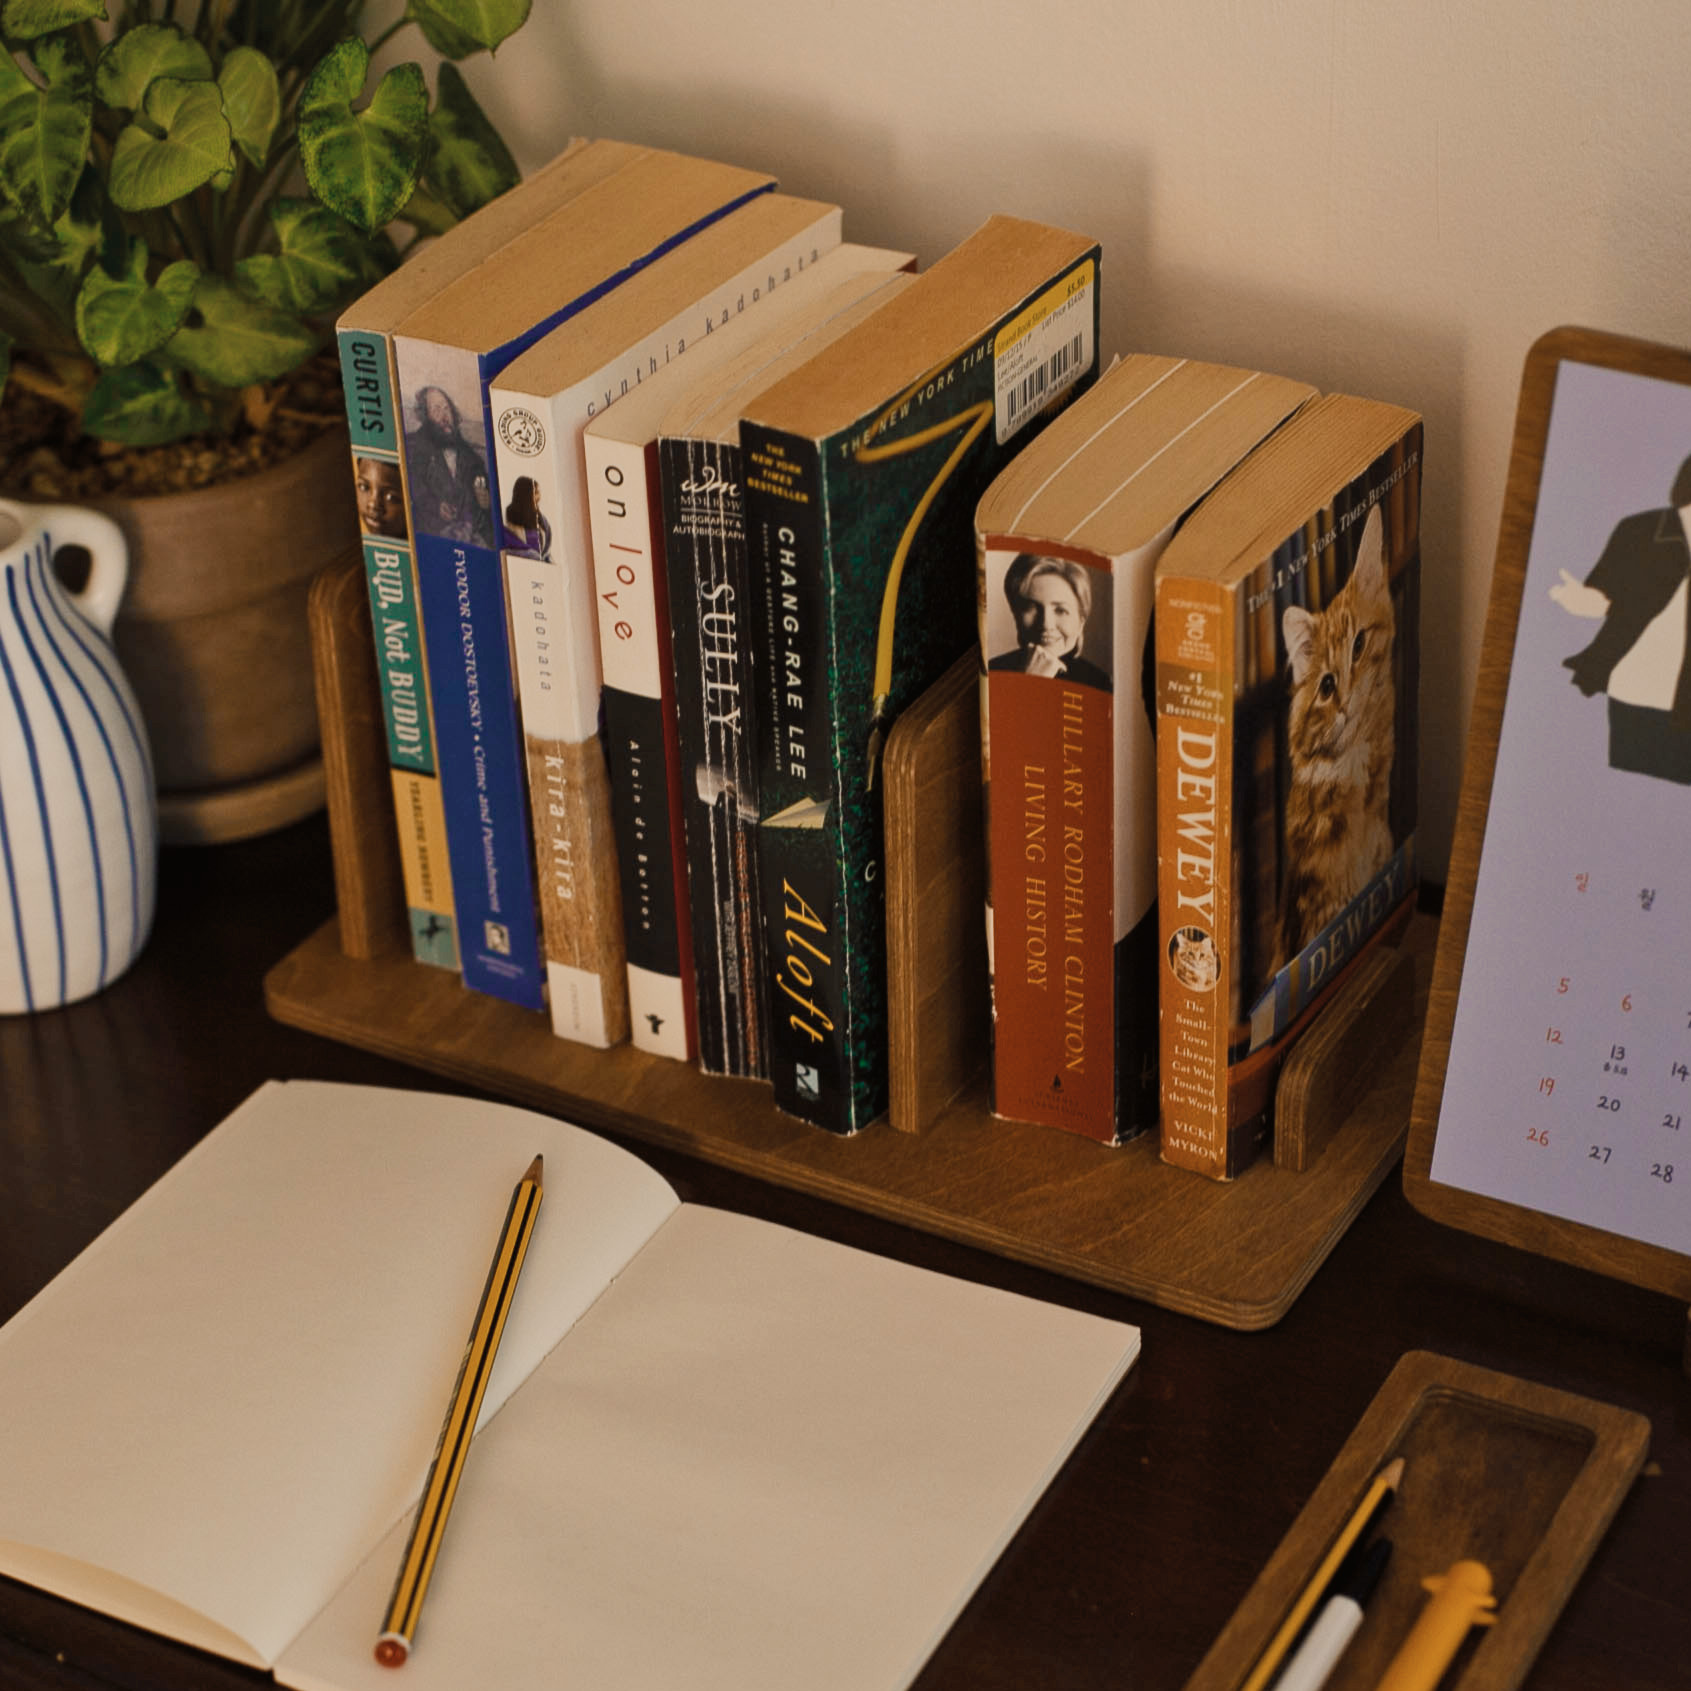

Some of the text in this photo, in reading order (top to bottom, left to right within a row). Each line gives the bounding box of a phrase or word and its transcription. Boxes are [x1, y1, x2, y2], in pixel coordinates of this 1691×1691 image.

[587, 250, 818, 417] cynthia kadohata
[351, 341, 385, 433] CURTIS
[840, 337, 994, 459] THE NEW YORK TIME
[751, 452, 802, 476] NEW YORK
[766, 443, 785, 457] THE
[747, 476, 809, 504] BESTSELLER
[762, 469, 793, 486] TIMES
[673, 523, 745, 540] AUTOBIOGRAPH
[682, 514, 733, 526] BIOGRAPHY
[1288, 553, 1309, 577] NEW
[1339, 499, 1368, 532] TIMES
[1368, 451, 1419, 508] BESTSELLER
[602, 465, 643, 640] on love
[453, 548, 472, 618] FYODOR
[382, 617, 411, 663] Not
[530, 580, 551, 692] kadohata
[700, 580, 742, 736] SULLY
[778, 526, 806, 780] CHANG-RAE LEE
[461, 622, 483, 732] DOSTOEVSKY
[388, 669, 424, 764] BUDDY
[473, 745, 487, 791] Crime
[545, 754, 576, 900] kira-kira
[634, 817, 646, 840] de
[1176, 726, 1217, 927] DEWEY
[1024, 764, 1048, 992] LIVING HISTORY
[1062, 690, 1085, 1074] HILLARY RODHAM CLINTON
[1306, 860, 1400, 993] DEWEY
[776, 877, 834, 1043] Aloft
[1175, 1013, 1211, 1031] Small-
[1184, 999, 1205, 1014] The
[1556, 977, 1632, 1013] 5 6
[1174, 1045, 1215, 1066] Library
[1181, 1031, 1208, 1047] Town
[1546, 1028, 1690, 1082] 12 13 14
[1169, 1091, 1185, 1104] the
[1172, 1060, 1215, 1081] Cat Who
[1172, 1076, 1215, 1097] Touched
[1174, 1120, 1213, 1142] VICKI
[1539, 1077, 1681, 1131] 19 20 21
[1168, 1136, 1218, 1161] MYRON
[1527, 1127, 1674, 1184] 26 27 28
